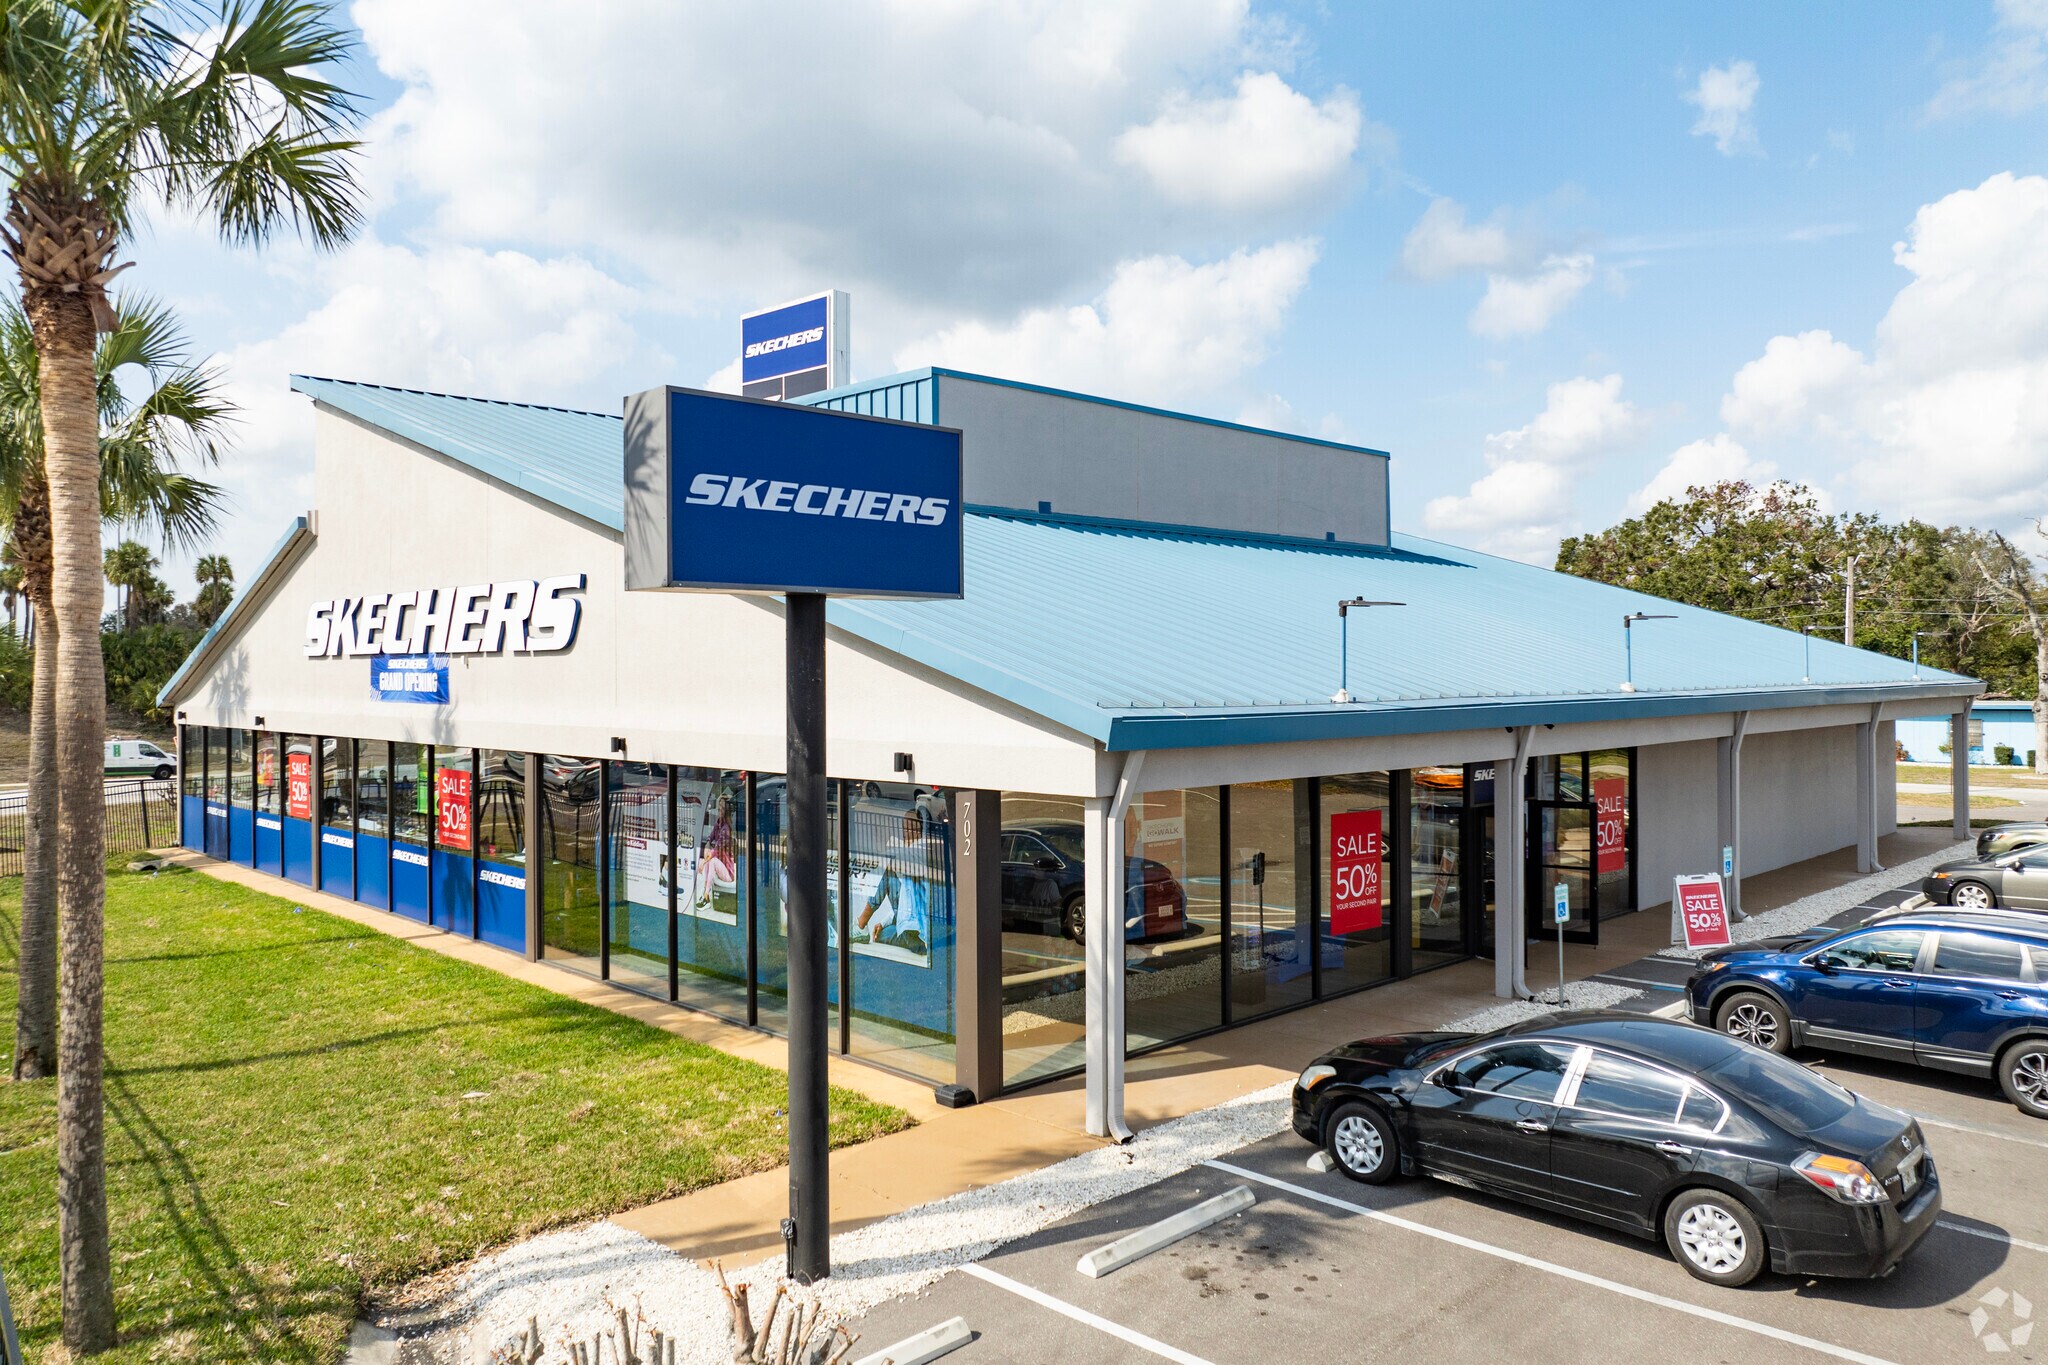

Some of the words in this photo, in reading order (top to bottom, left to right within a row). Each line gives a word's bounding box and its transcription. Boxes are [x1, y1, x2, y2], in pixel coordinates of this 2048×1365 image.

[744, 326, 825, 358] SKECHERS
[685, 473, 950, 526] SKECHERS
[303, 573, 587, 657] SKECHERS
[379, 671, 404, 691] GRAND
[404, 671, 438, 692] OPENING
[291, 761, 307, 776] SALE
[442, 776, 466, 796] SALE
[1597, 795, 1622, 814] SALE
[442, 802, 467, 830] 50%
[963, 802, 972, 856] 702
[1596, 818, 1622, 848] 50%
[1337, 832, 1377, 857] SALE
[391, 848, 429, 867] SKECHERS
[479, 869, 527, 890] SKECHERS
[1335, 862, 1378, 900] 50%
[1364, 886, 1377, 896] OFF
[1336, 902, 1349, 910] YOUR
[1349, 899, 1367, 908] SECOND
[1686, 899, 1720, 912] SALE
[1689, 912, 1722, 929] 50%
